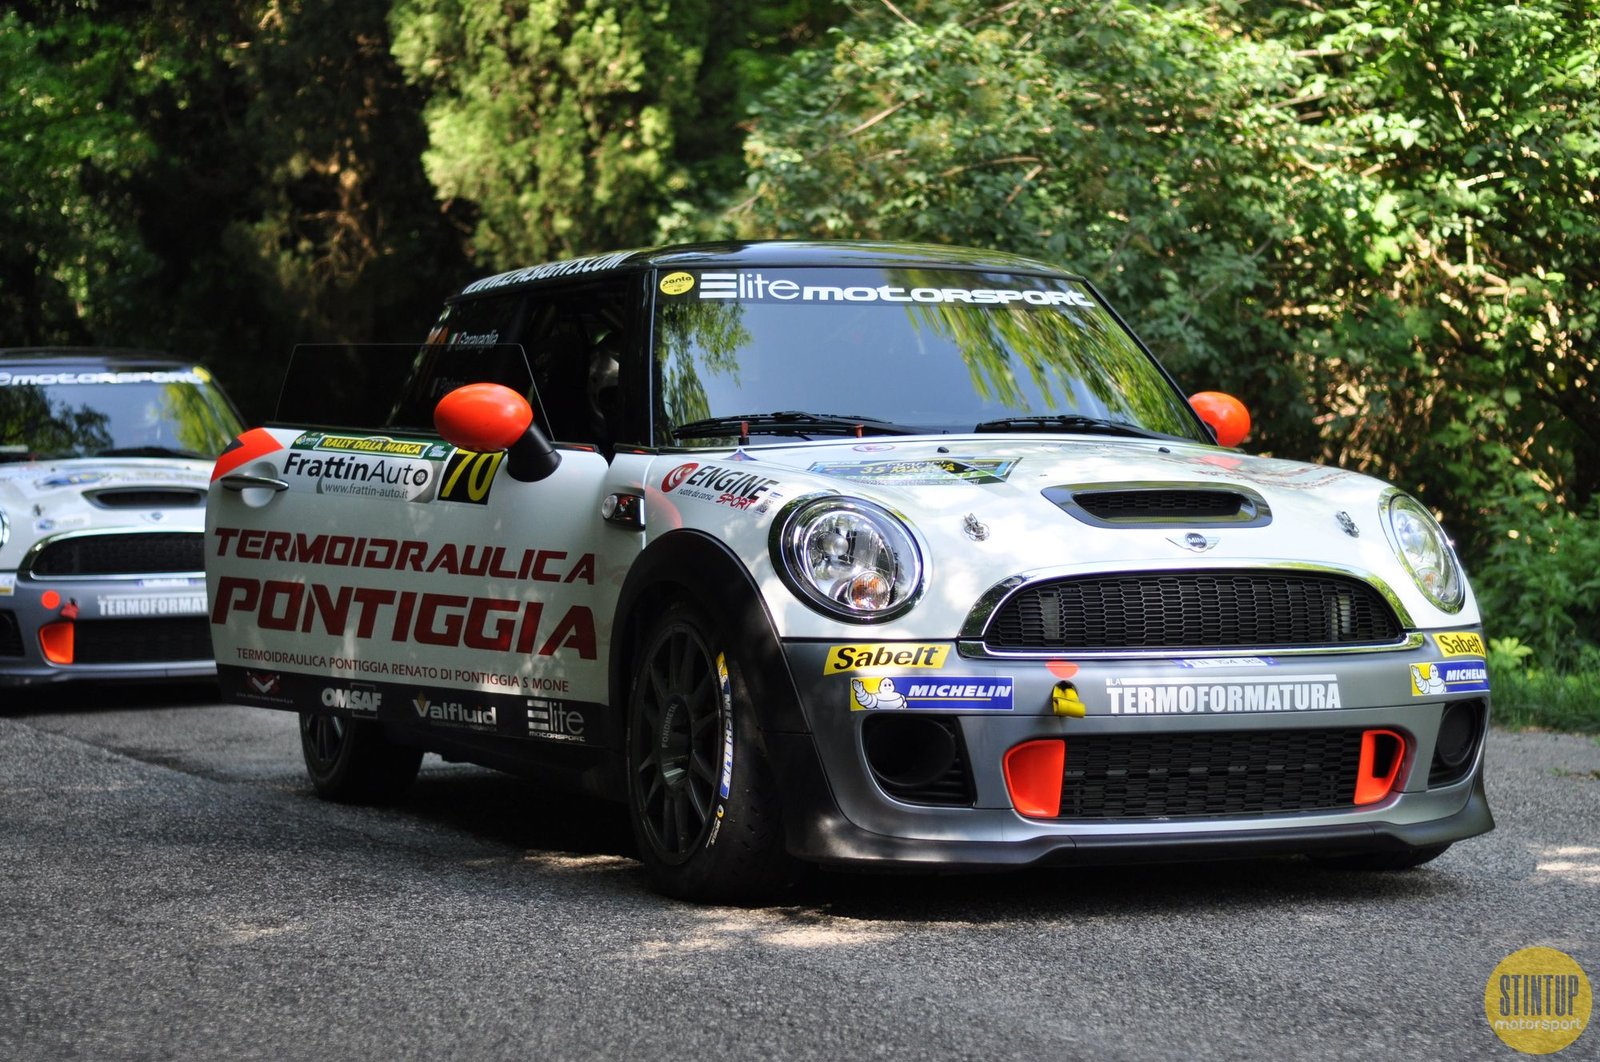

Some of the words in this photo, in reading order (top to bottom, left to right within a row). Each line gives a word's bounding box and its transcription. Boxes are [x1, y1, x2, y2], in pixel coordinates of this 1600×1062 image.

[322, 437, 354, 450] RALLY
[352, 440, 383, 452] DELLA
[384, 443, 422, 455] MARCA
[440, 448, 502, 501] 70
[686, 465, 780, 501] ENGINE
[324, 483, 409, 499] www.frattin-auto.it
[715, 493, 757, 511] SPORT
[215, 527, 596, 586] TERMOIDRAULICA
[211, 575, 598, 661] PONTIGGIA
[833, 645, 940, 671] Sabelt
[1439, 634, 1485, 655] Sabelt
[235, 647, 326, 669] TERMOIDRAULICA
[329, 658, 390, 675] PONTIGGIA
[391, 663, 438, 680] RENATO
[440, 668, 453, 682] DI
[454, 670, 520, 688] PONTIGGIA
[321, 687, 383, 712] OMSAF
[908, 684, 1012, 698] MICHELIN
[1107, 682, 1342, 714] TERMOFORMATURA
[412, 698, 498, 726] Valfluid
